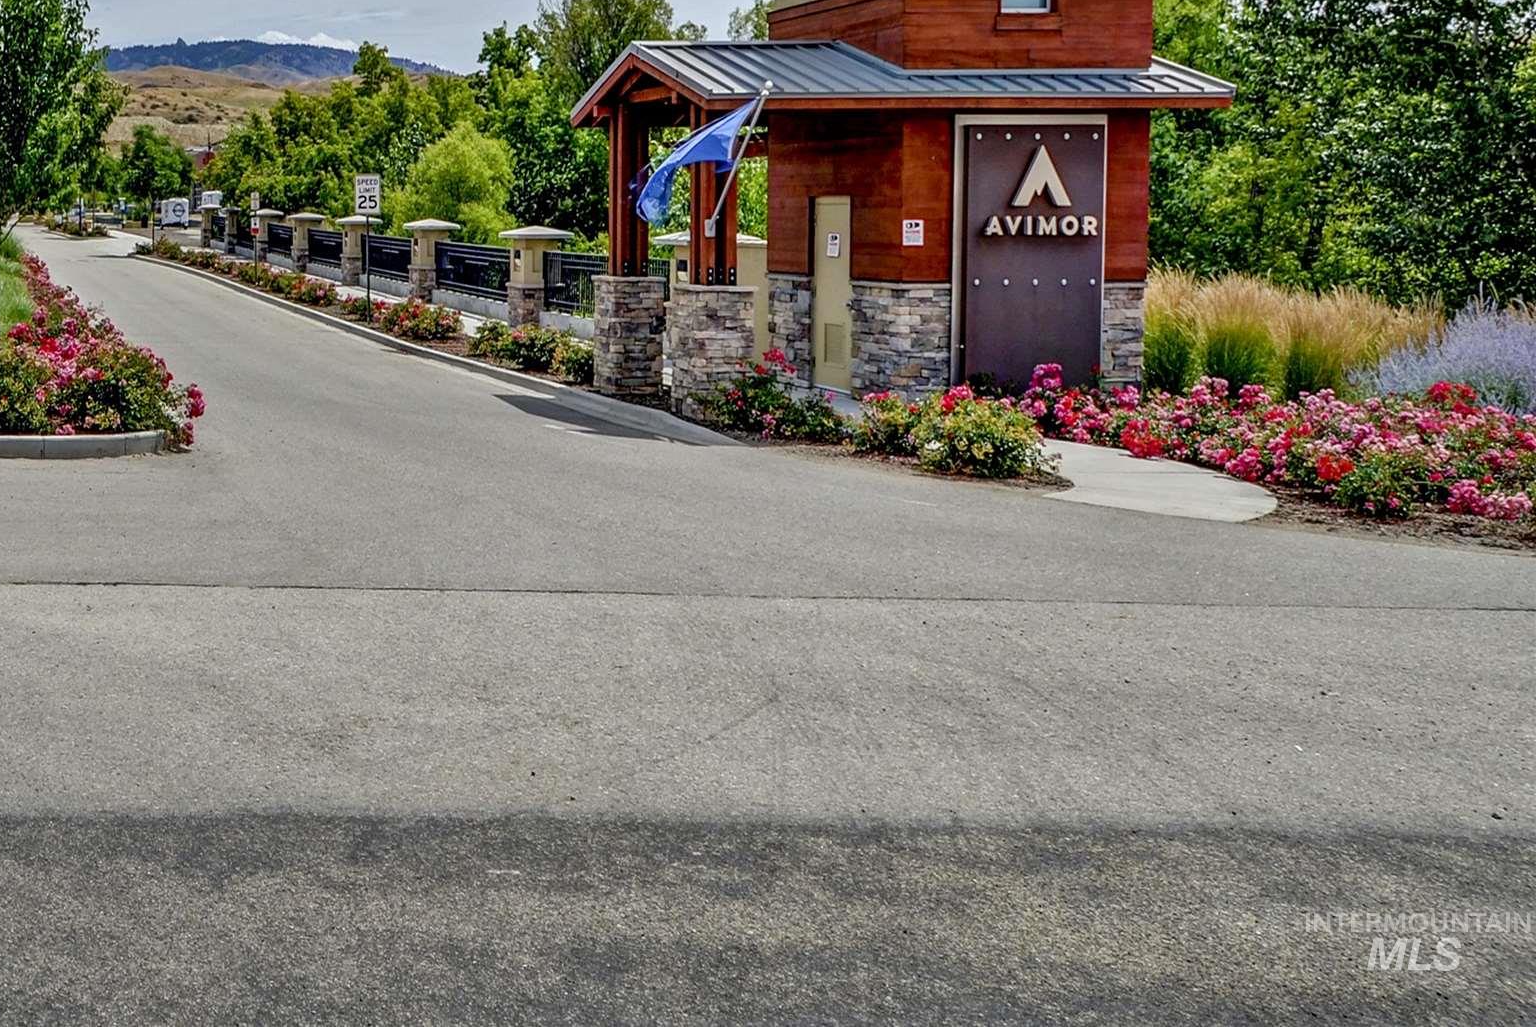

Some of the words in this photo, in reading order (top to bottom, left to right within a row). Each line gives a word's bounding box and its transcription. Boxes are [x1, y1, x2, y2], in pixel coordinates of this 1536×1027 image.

[357, 178, 378, 186] SPEED
[358, 195, 378, 209] 25
[985, 216, 1098, 236] AVIMOR
